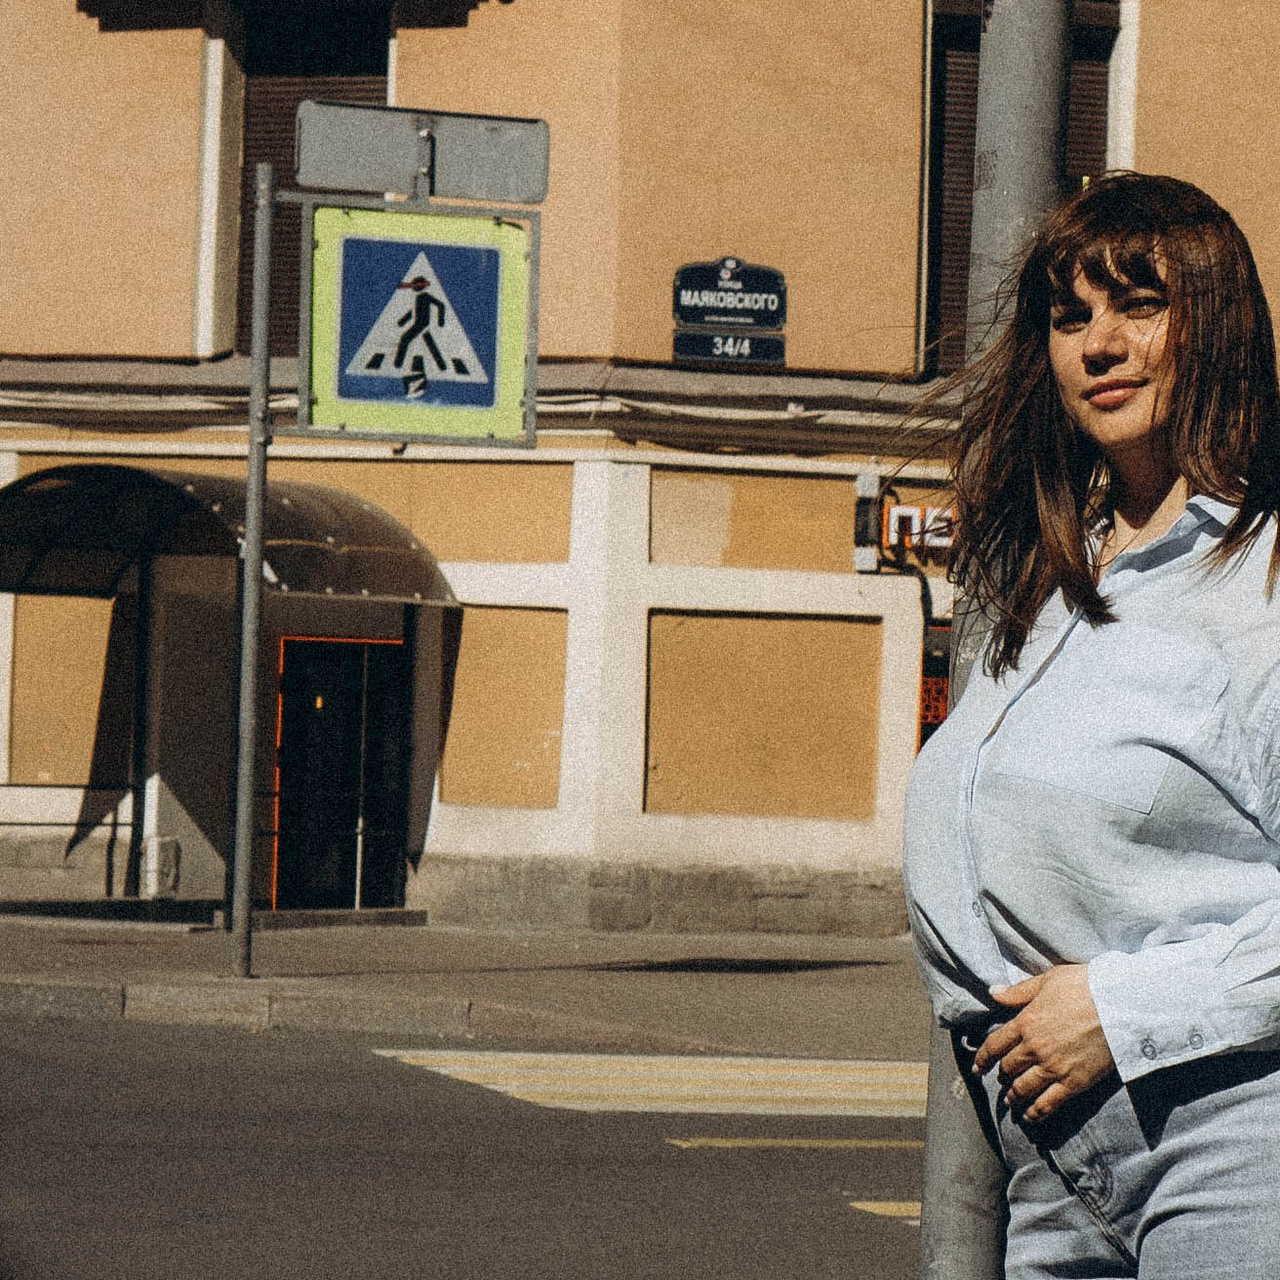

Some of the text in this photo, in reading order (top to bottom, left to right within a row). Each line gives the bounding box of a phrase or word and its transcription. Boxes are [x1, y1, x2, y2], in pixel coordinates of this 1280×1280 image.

[680, 289, 779, 312] МАЯКОВСКОГО
[711, 336, 751, 357] 34/4
[884, 505, 957, 548] ПЕ
